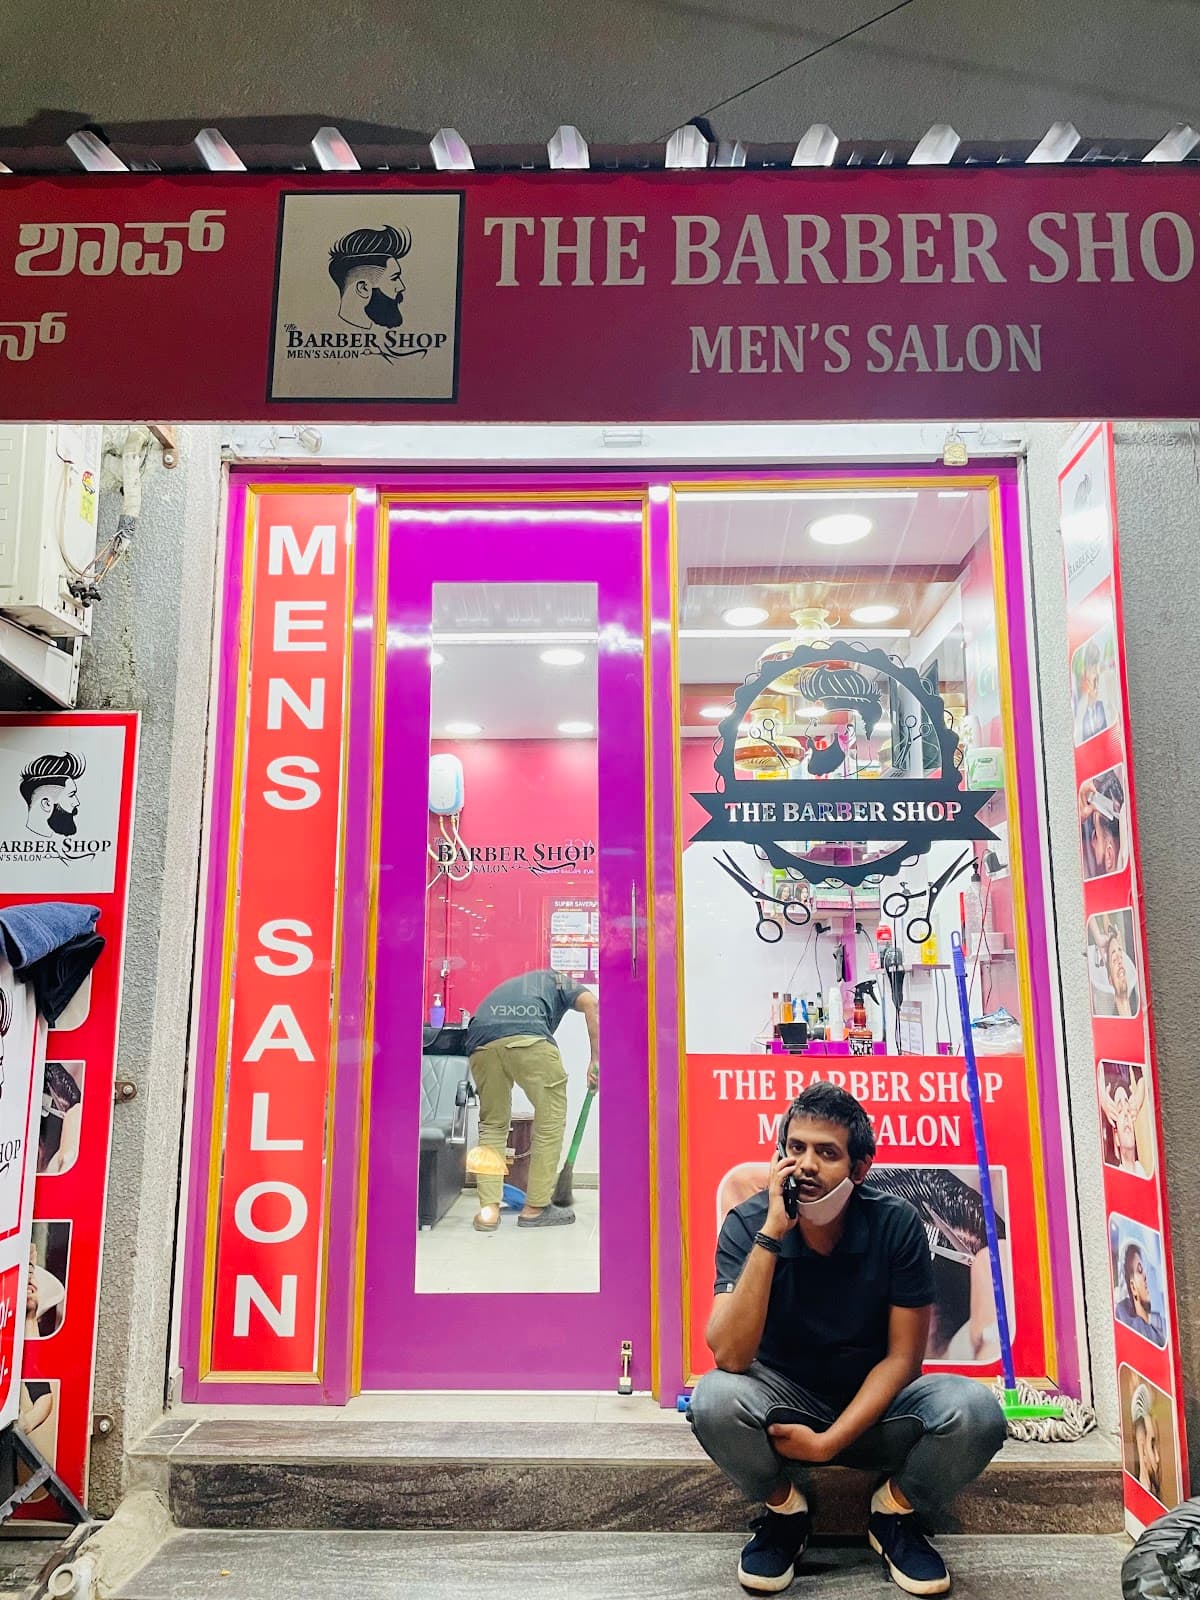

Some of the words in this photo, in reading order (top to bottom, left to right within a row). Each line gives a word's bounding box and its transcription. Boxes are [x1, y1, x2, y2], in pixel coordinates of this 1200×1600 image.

[15, 209, 227, 277] ಶಾಪ್
[484, 215, 646, 288] THE
[671, 212, 1007, 287] BARBER
[286, 330, 378, 348] BARBER
[384, 330, 447, 348] SHOP
[689, 324, 851, 374] MEN'S
[866, 323, 1043, 373] SALON
[287, 349, 320, 359] MEN'S
[323, 349, 360, 359] SALON
[262, 525, 337, 811] MENS
[724, 802, 777, 823] THE
[783, 801, 887, 823] BARBER
[893, 801, 962, 822] SHOP
[62, 838, 112, 852] SHOP
[438, 844, 527, 862] BARBER
[533, 844, 595, 862] SHOP
[13, 854, 42, 862] SALON
[472, 864, 508, 873] SALON
[712, 1069, 776, 1101] THE
[232, 918, 316, 1338] SALON
